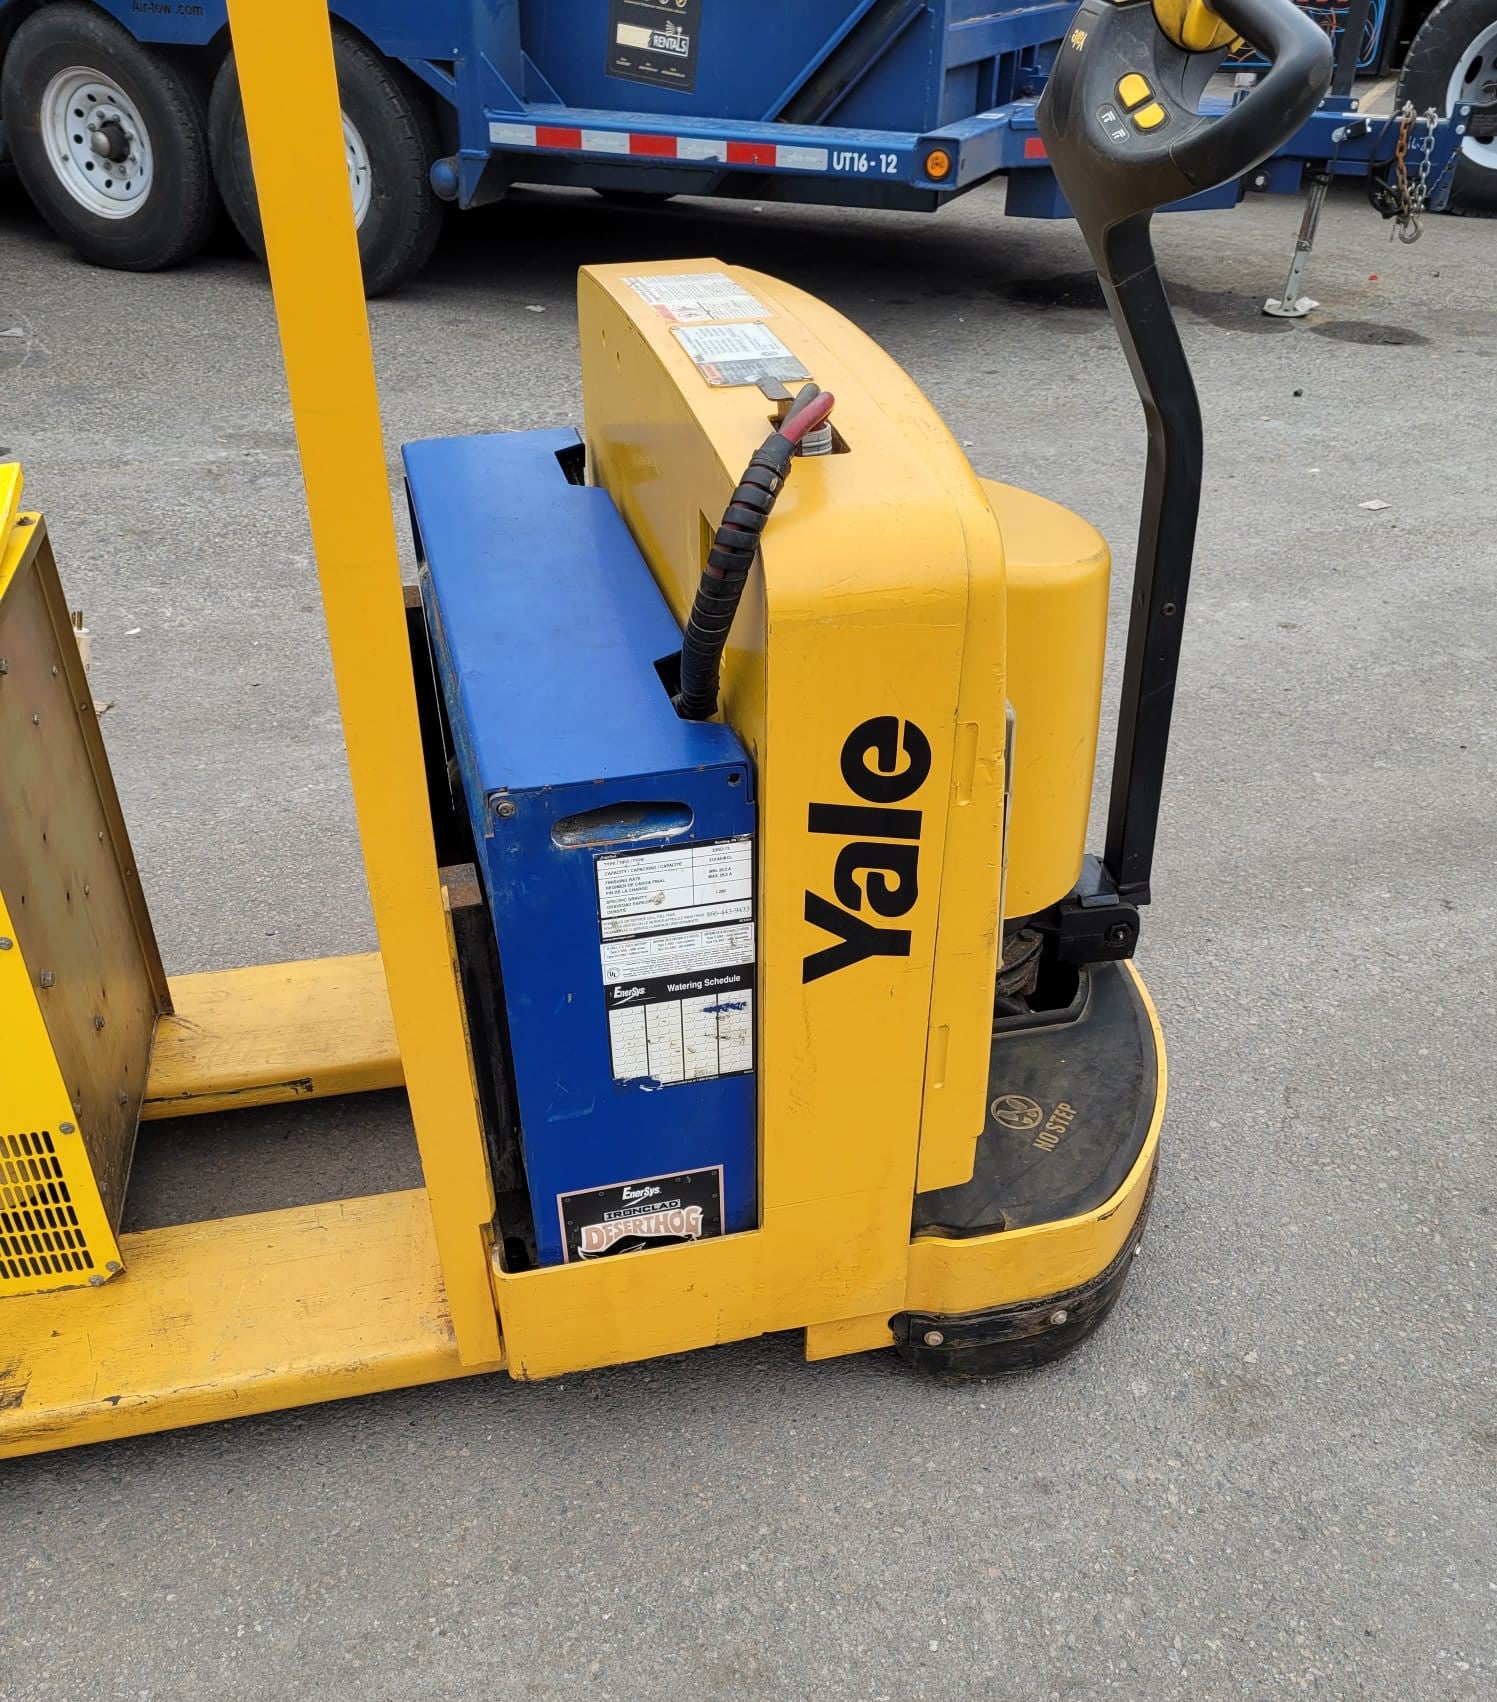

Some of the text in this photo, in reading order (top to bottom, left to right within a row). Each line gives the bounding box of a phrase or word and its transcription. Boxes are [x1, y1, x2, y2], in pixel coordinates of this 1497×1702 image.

[652, 34, 686, 53] RENTALS
[802, 715, 932, 984] Yale
[613, 986, 646, 999] EnerSys
[667, 974, 741, 993] Watering Schedule
[1032, 1102, 1077, 1153] NO STEP
[622, 1186, 661, 1201] EnerSys
[606, 1200, 679, 1220] IRONCLAD
[583, 1207, 703, 1251] DESERTHOG
